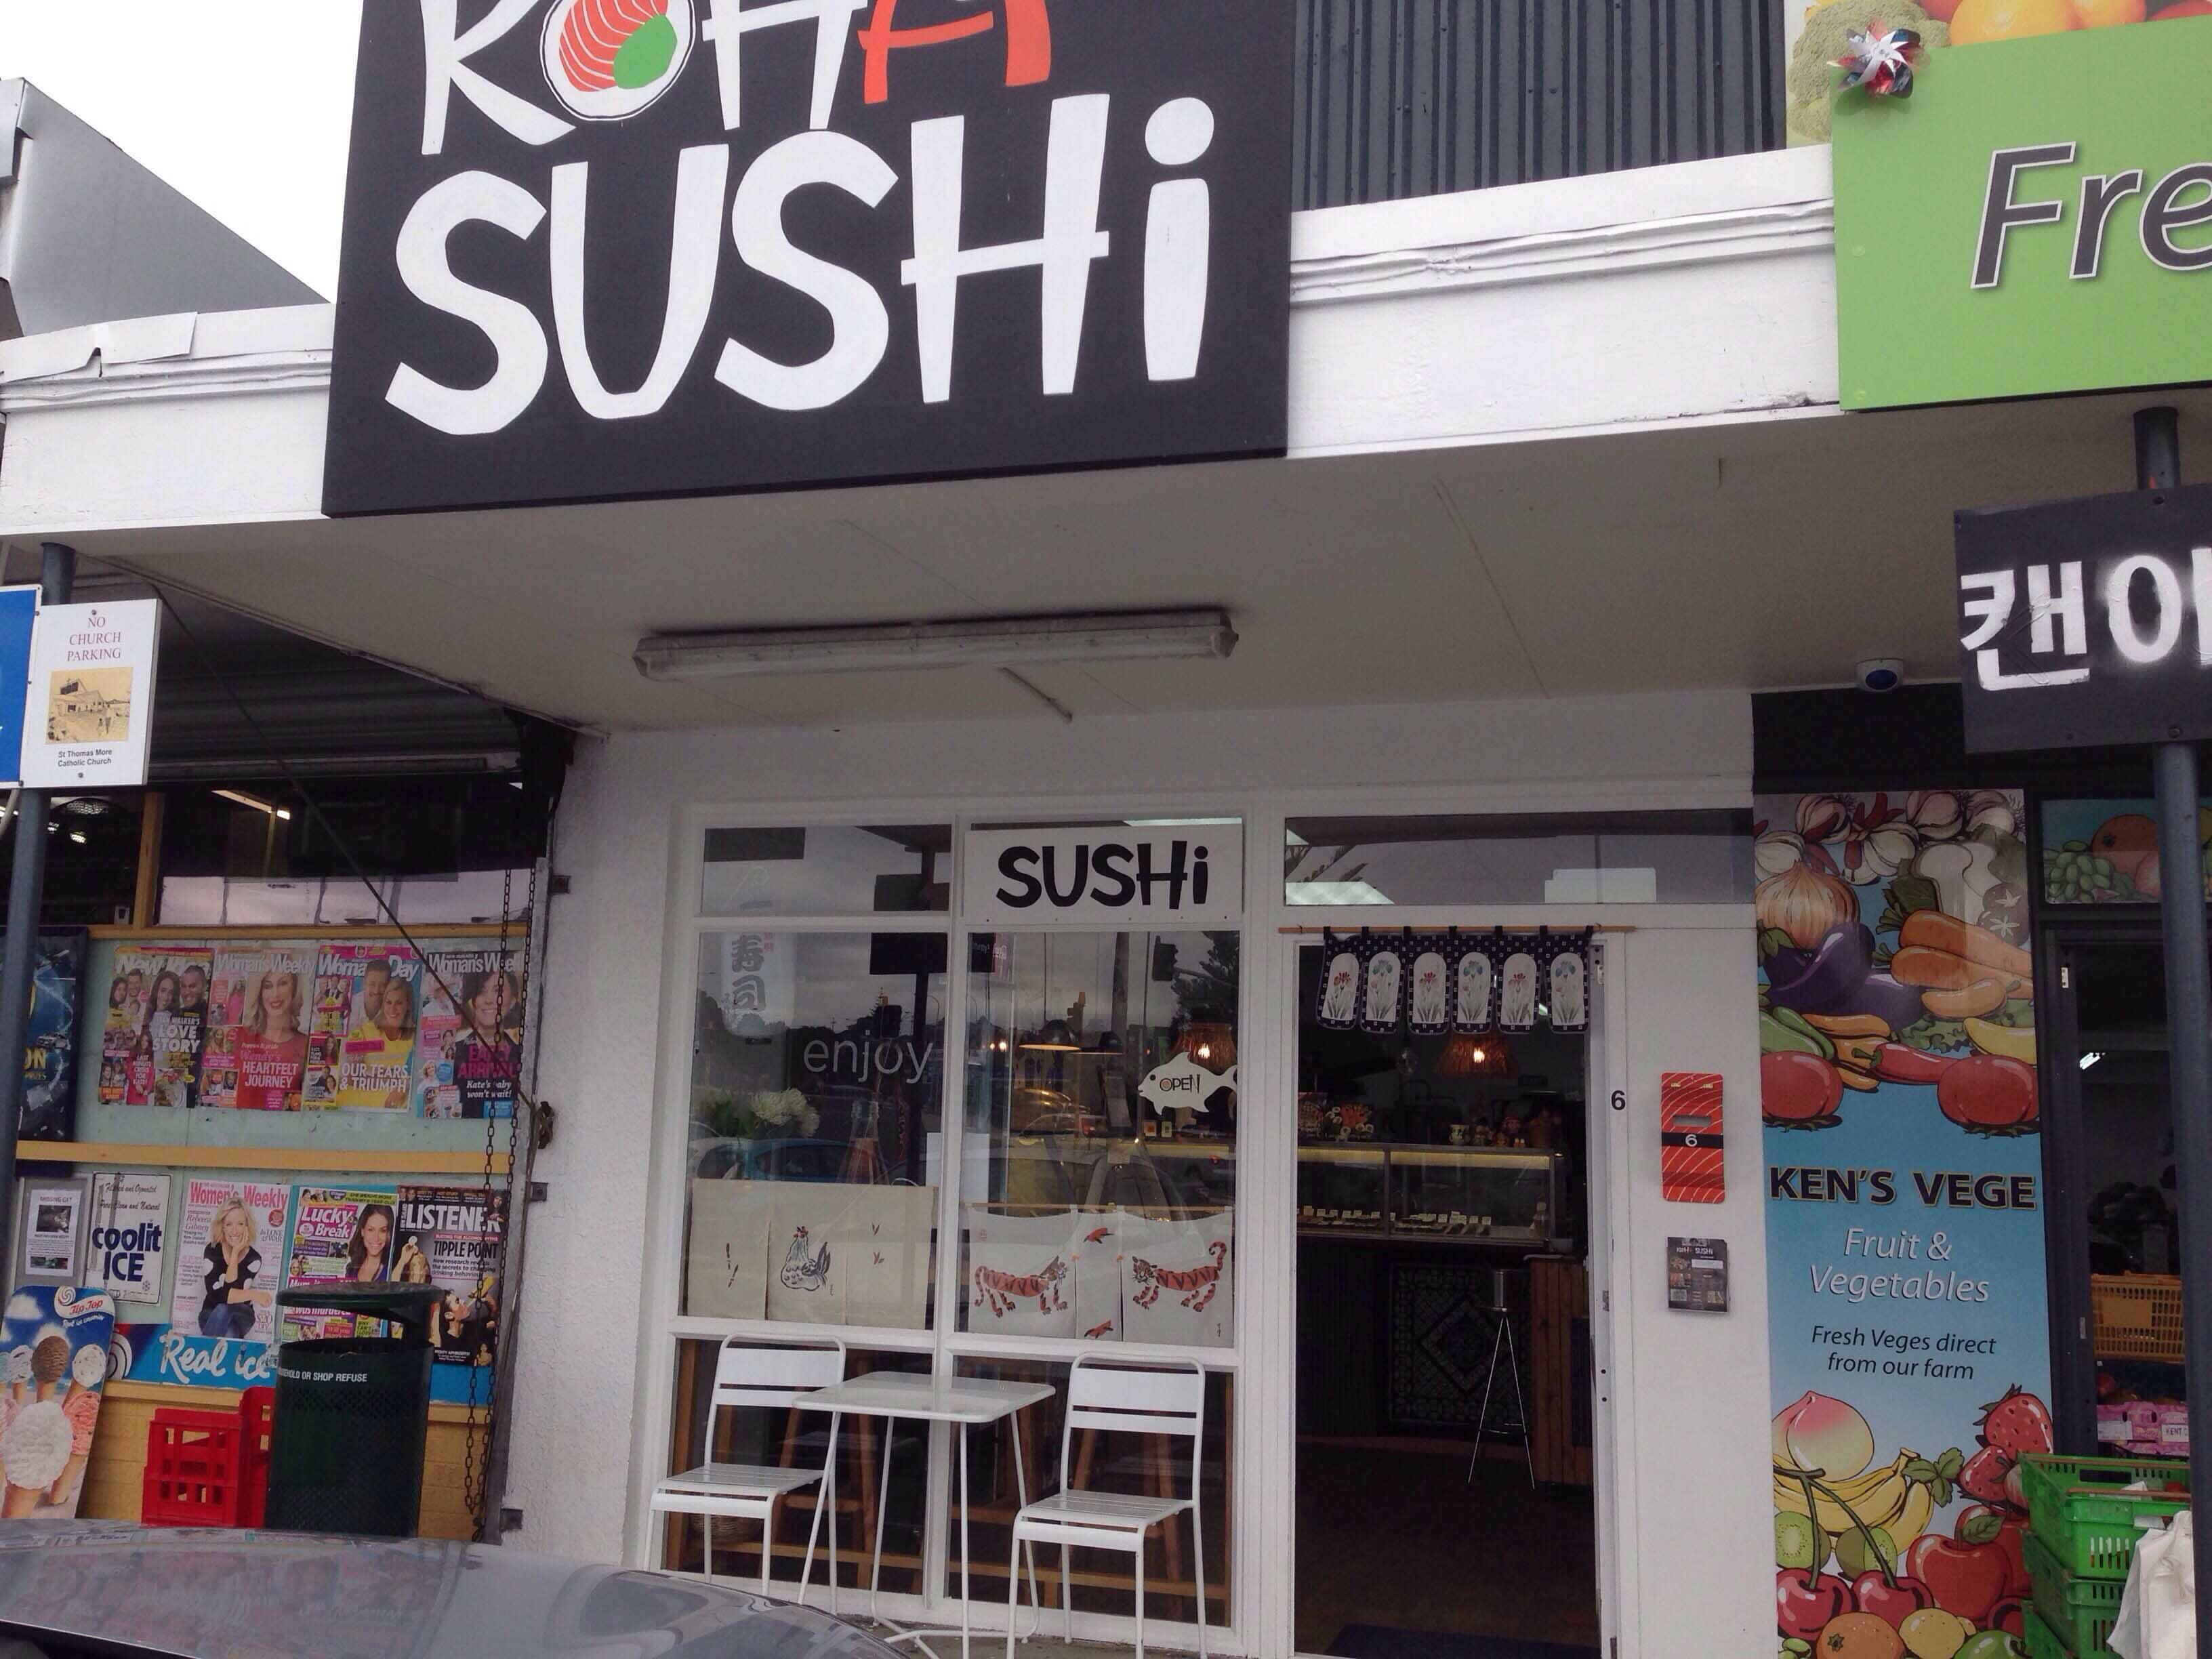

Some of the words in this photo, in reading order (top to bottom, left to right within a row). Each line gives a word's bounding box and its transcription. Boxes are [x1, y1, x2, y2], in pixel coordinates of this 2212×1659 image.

[87, 617, 106, 629] NO
[69, 631, 121, 646] CHURCH
[67, 647, 121, 661] PARKING
[67, 750, 94, 758] Thomas
[95, 748, 112, 757] More
[58, 758, 86, 767] Catholic
[87, 757, 112, 766] Church
[319, 954, 368, 977] Woma
[388, 955, 419, 982] Day
[428, 954, 484, 974] Woman's
[159, 1025, 197, 1039] LOVE
[152, 1038, 201, 1053] STORY
[803, 1029, 934, 1084] enjoy
[243, 1061, 299, 1076] HEARTFELT
[342, 1063, 367, 1077] OUR
[370, 1064, 409, 1078] TEARS
[245, 1074, 293, 1088] JOURNEY
[340, 1078, 348, 1090] &
[351, 1078, 407, 1093] TRIUMPH
[466, 1080, 491, 1089] Kate's
[493, 1080, 512, 1090] aby
[1159, 1073, 1201, 1094] OPEN
[466, 1090, 489, 1099] won't
[1610, 1090, 1626, 1111] 6
[1685, 1134, 1698, 1147] 6
[1768, 1165, 1897, 1206] KEN'S
[1911, 1171, 2037, 1210] VEGE
[190, 1181, 239, 1205] Women's
[243, 1185, 289, 1211] Weekly
[302, 1207, 353, 1227] Lucky
[407, 1204, 501, 1232] LISTENER
[92, 1223, 163, 1253] coolit
[314, 1223, 350, 1239] Break
[434, 1241, 468, 1257] TIPPLE
[468, 1242, 499, 1259] PONT
[1843, 1227, 1921, 1260] Fruit
[1927, 1231, 1953, 1261] &
[103, 1251, 145, 1282] ICE
[1809, 1264, 1990, 1304] Vegetables
[70, 1304, 84, 1315] Tip
[85, 1299, 104, 1311] Top
[1811, 1326, 1866, 1347] Fresh
[1871, 1329, 1931, 1354] Veges
[1936, 1332, 1996, 1355] direct
[159, 1330, 228, 1385] Real
[1827, 1352, 1877, 1374] from
[1883, 1361, 1919, 1378] our
[1923, 1357, 1974, 1380] farm
[302, 1371, 312, 1380] OR
[313, 1372, 334, 1382] SHOP
[335, 1373, 369, 1383] REFUSE
[2165, 1427, 2182, 1436] KENT
